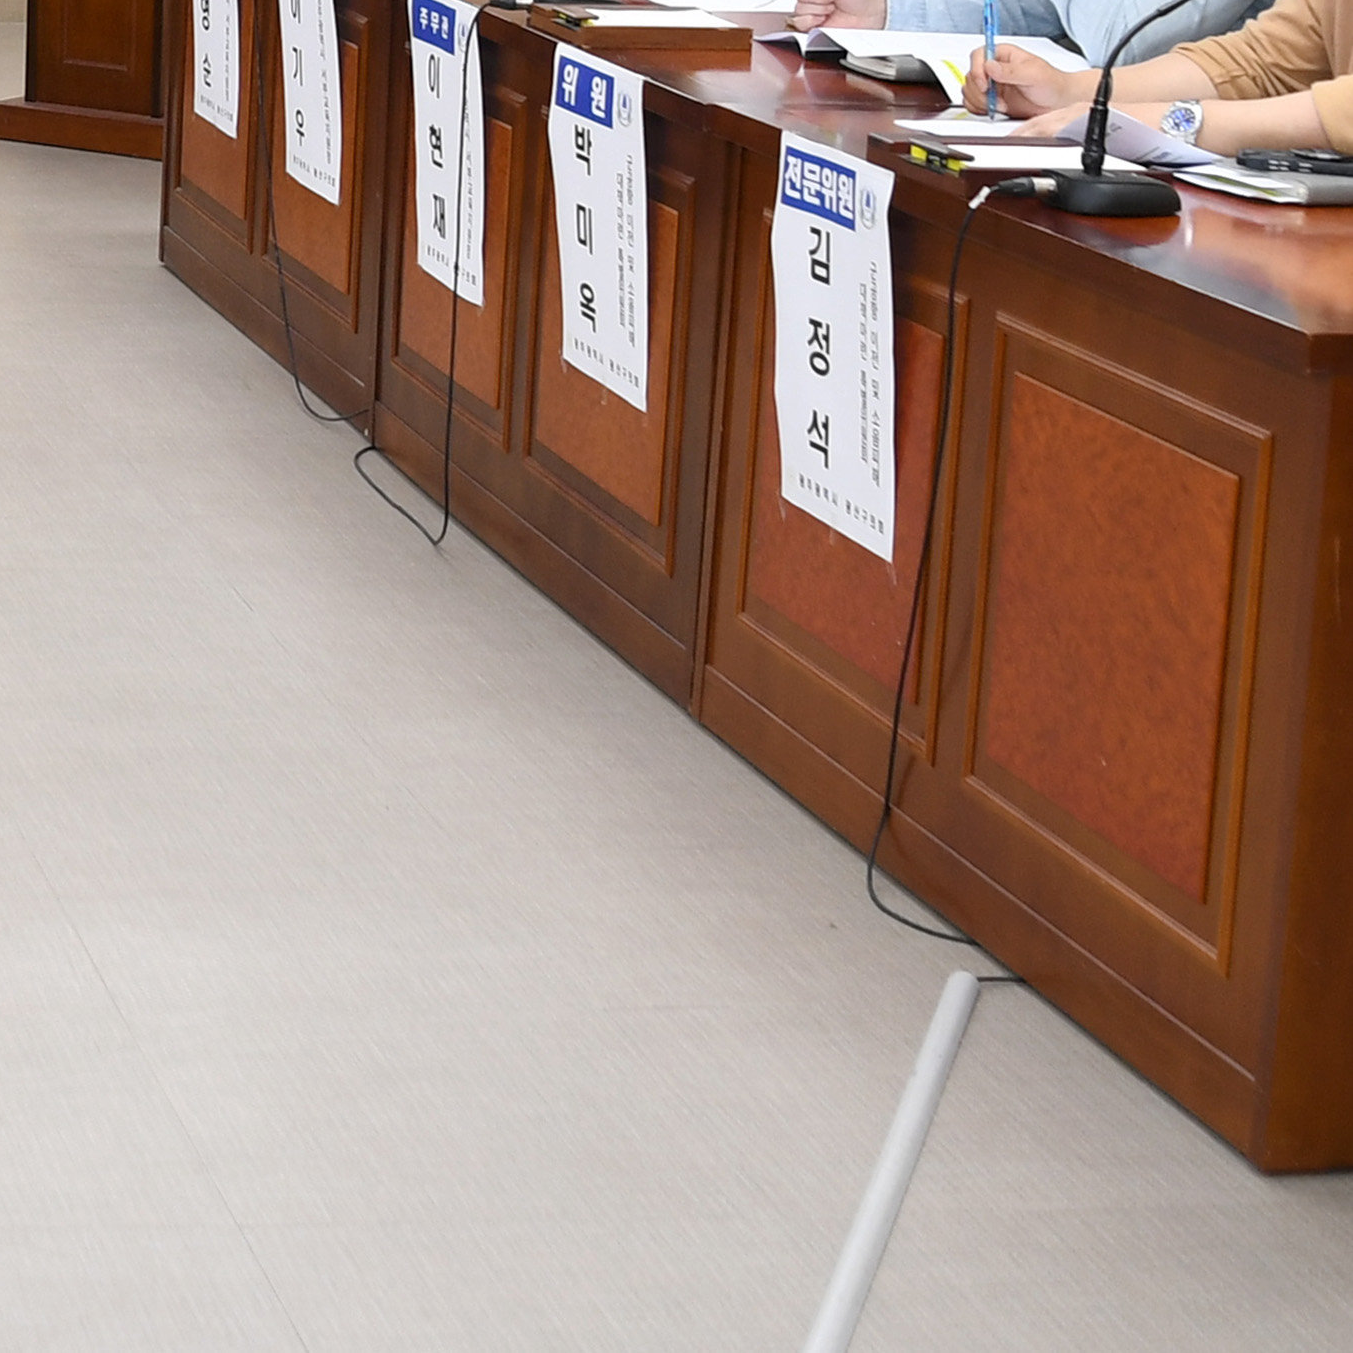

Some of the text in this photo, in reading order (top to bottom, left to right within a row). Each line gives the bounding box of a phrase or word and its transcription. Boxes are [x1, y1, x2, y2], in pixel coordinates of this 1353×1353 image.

[420, 8, 448, 39] 주무관
[429, 54, 445, 239] 이현재
[575, 125, 596, 332] 박미옥
[783, 151, 853, 219] 전문위원
[807, 227, 830, 469] 김정석
